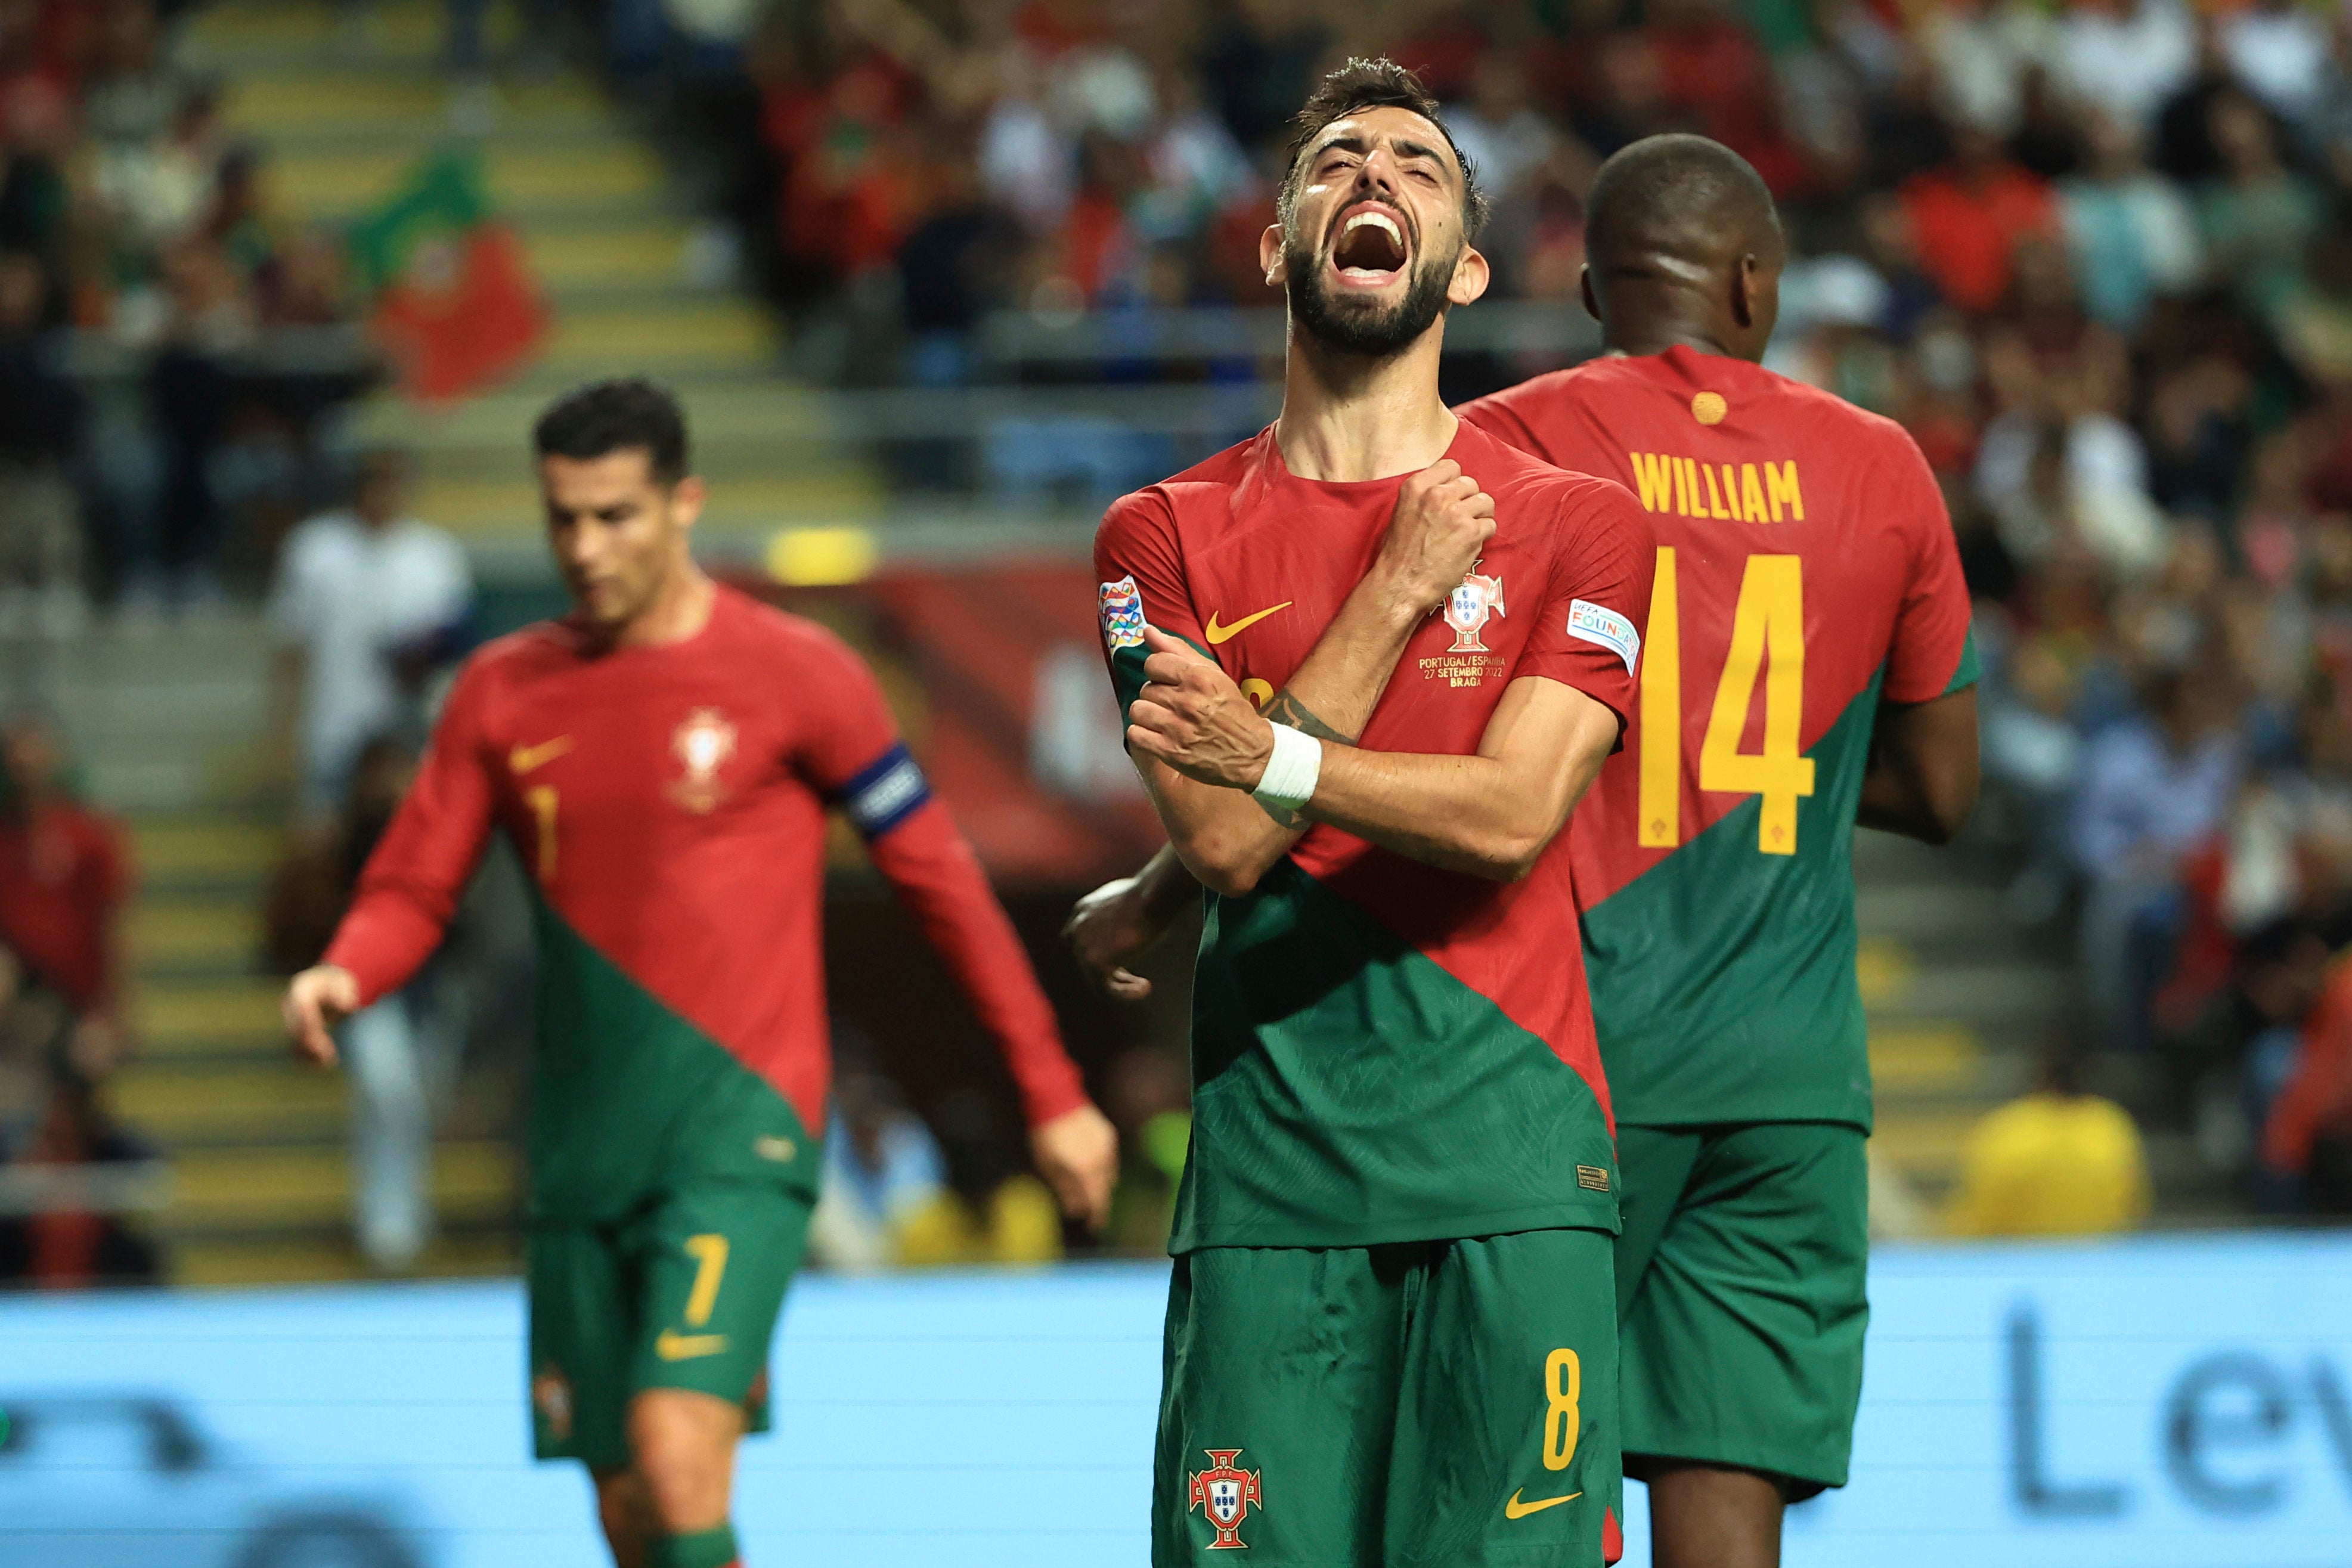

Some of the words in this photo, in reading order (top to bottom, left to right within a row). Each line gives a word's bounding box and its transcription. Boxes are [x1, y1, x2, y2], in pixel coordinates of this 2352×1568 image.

[1629, 451, 1804, 523] WILLIAM
[1574, 602, 1598, 615] UEFA
[1419, 655, 1505, 669] PORTUGAL/ESPANHA
[1424, 669, 1435, 680] 27
[1437, 667, 1483, 678] SETEMBRO
[1485, 667, 1502, 677] 2022
[1450, 677, 1482, 687] BRAGA
[1638, 546, 1815, 855] 14
[683, 1232, 730, 1328] 7
[1543, 1347, 1581, 1471] 8
